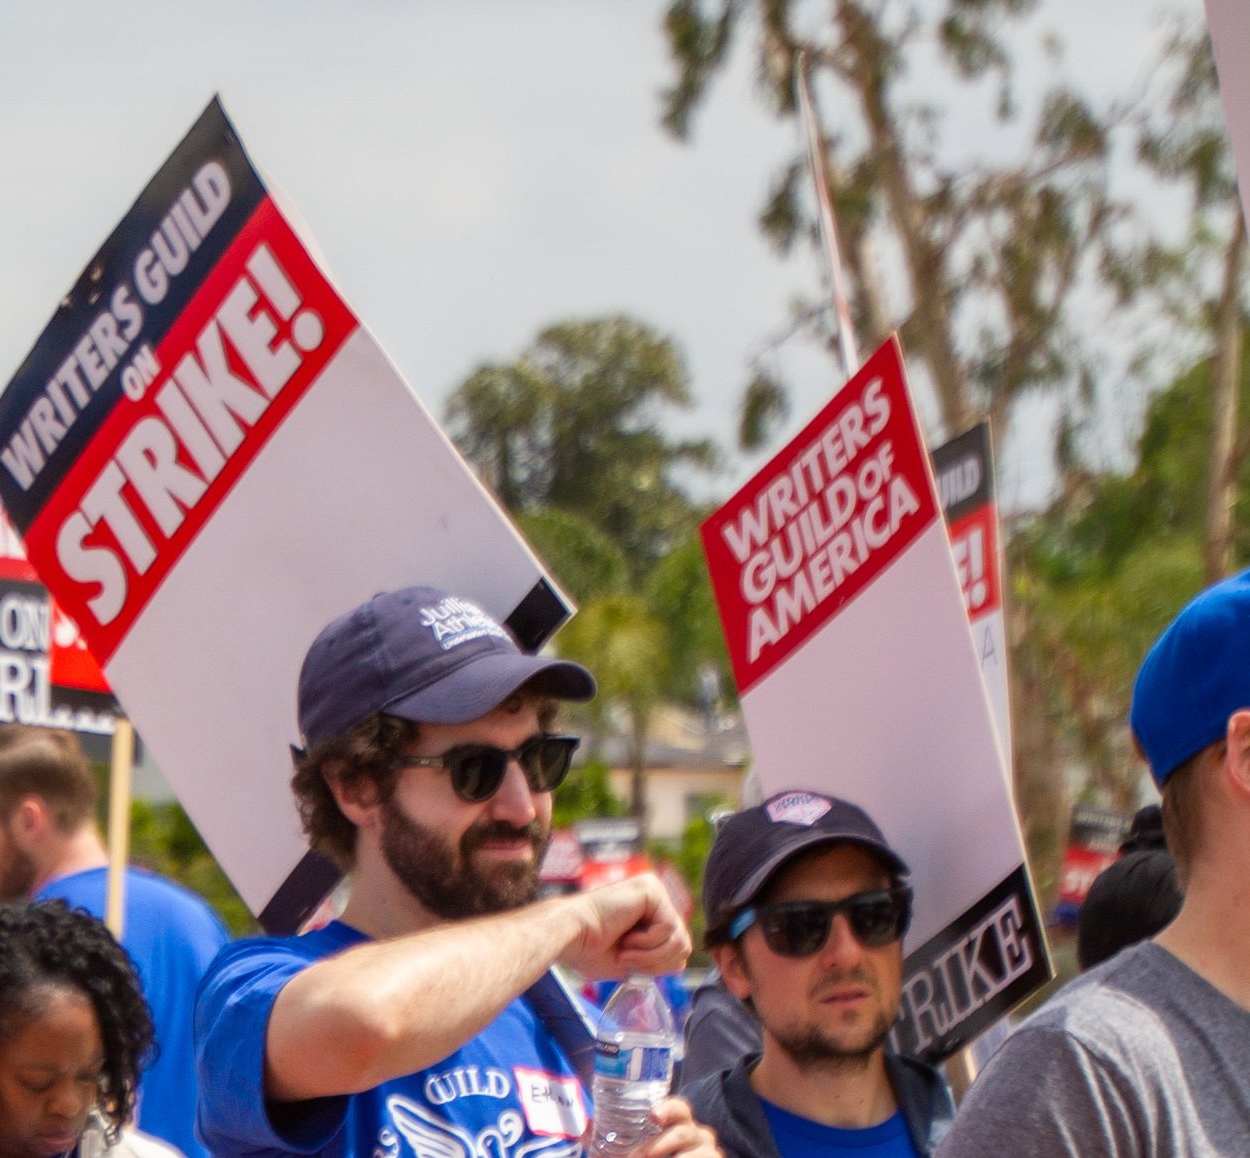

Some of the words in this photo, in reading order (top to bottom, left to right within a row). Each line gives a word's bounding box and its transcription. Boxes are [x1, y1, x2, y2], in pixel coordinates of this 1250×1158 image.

[0, 283, 144, 491] WRITERS
[133, 161, 231, 305] GUILD
[121, 345, 162, 402] ON
[55, 241, 325, 627] STRIKE!
[720, 376, 893, 564] WRITERS
[740, 474, 857, 605] GUILD
[857, 440, 896, 501] OF
[746, 473, 921, 665] AMERICA
[424, 1066, 512, 1106] GUILD
